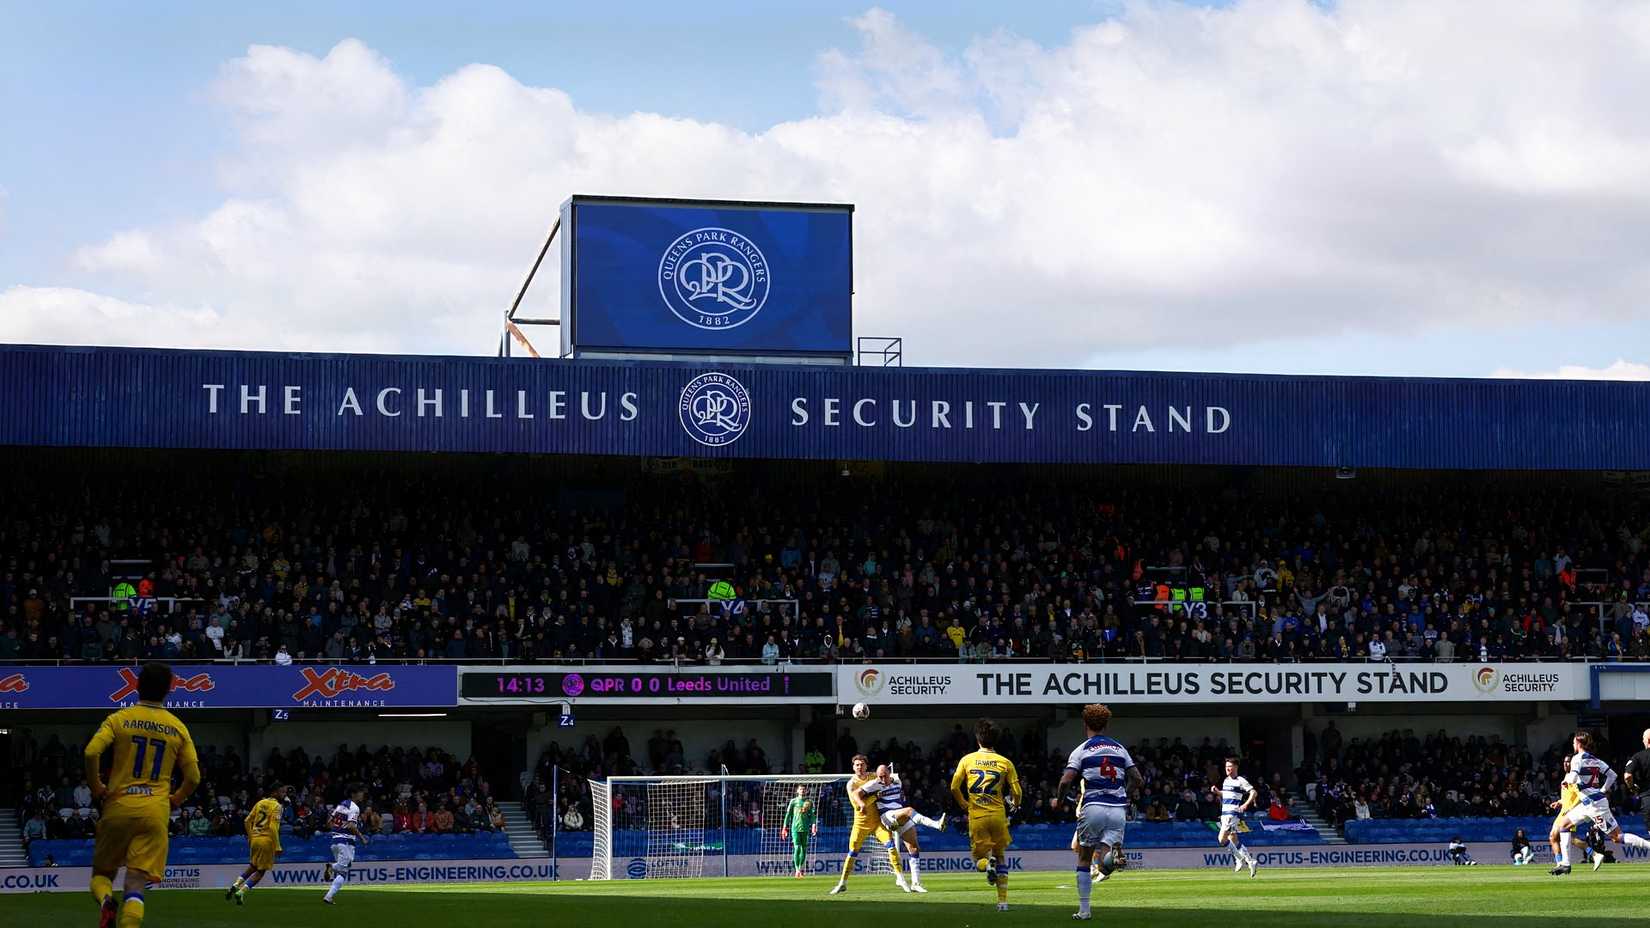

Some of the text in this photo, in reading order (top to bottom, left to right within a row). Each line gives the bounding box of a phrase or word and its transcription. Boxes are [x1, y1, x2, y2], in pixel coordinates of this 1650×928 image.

[663, 231, 766, 283] QUEENS PARK RANGERS
[699, 315, 730, 326] 1882
[682, 381, 702, 411] QUEENS
[703, 375, 724, 383] PARK
[202, 383, 1232, 433] THE ACHILLEUS SECURITY STAND
[1183, 602, 1208, 620] Y3
[292, 667, 396, 702] Xtra
[496, 677, 545, 693] 14:13
[590, 678, 625, 693] QPR
[631, 677, 642, 693] 0
[649, 678, 660, 692] 0
[667, 676, 713, 693] Leeds
[716, 676, 771, 693] United
[888, 676, 952, 686] ACHILLEUS
[976, 671, 1449, 696] THE ACHILLEUS SECURITY STAND
[1503, 674, 1559, 683] ACHILLEUS
[303, 700, 386, 708] MAINTENANCE
[123, 720, 178, 736] AARONSON
[560, 715, 574, 726] Z4
[132, 735, 167, 781] 11
[969, 769, 1001, 794] 22
